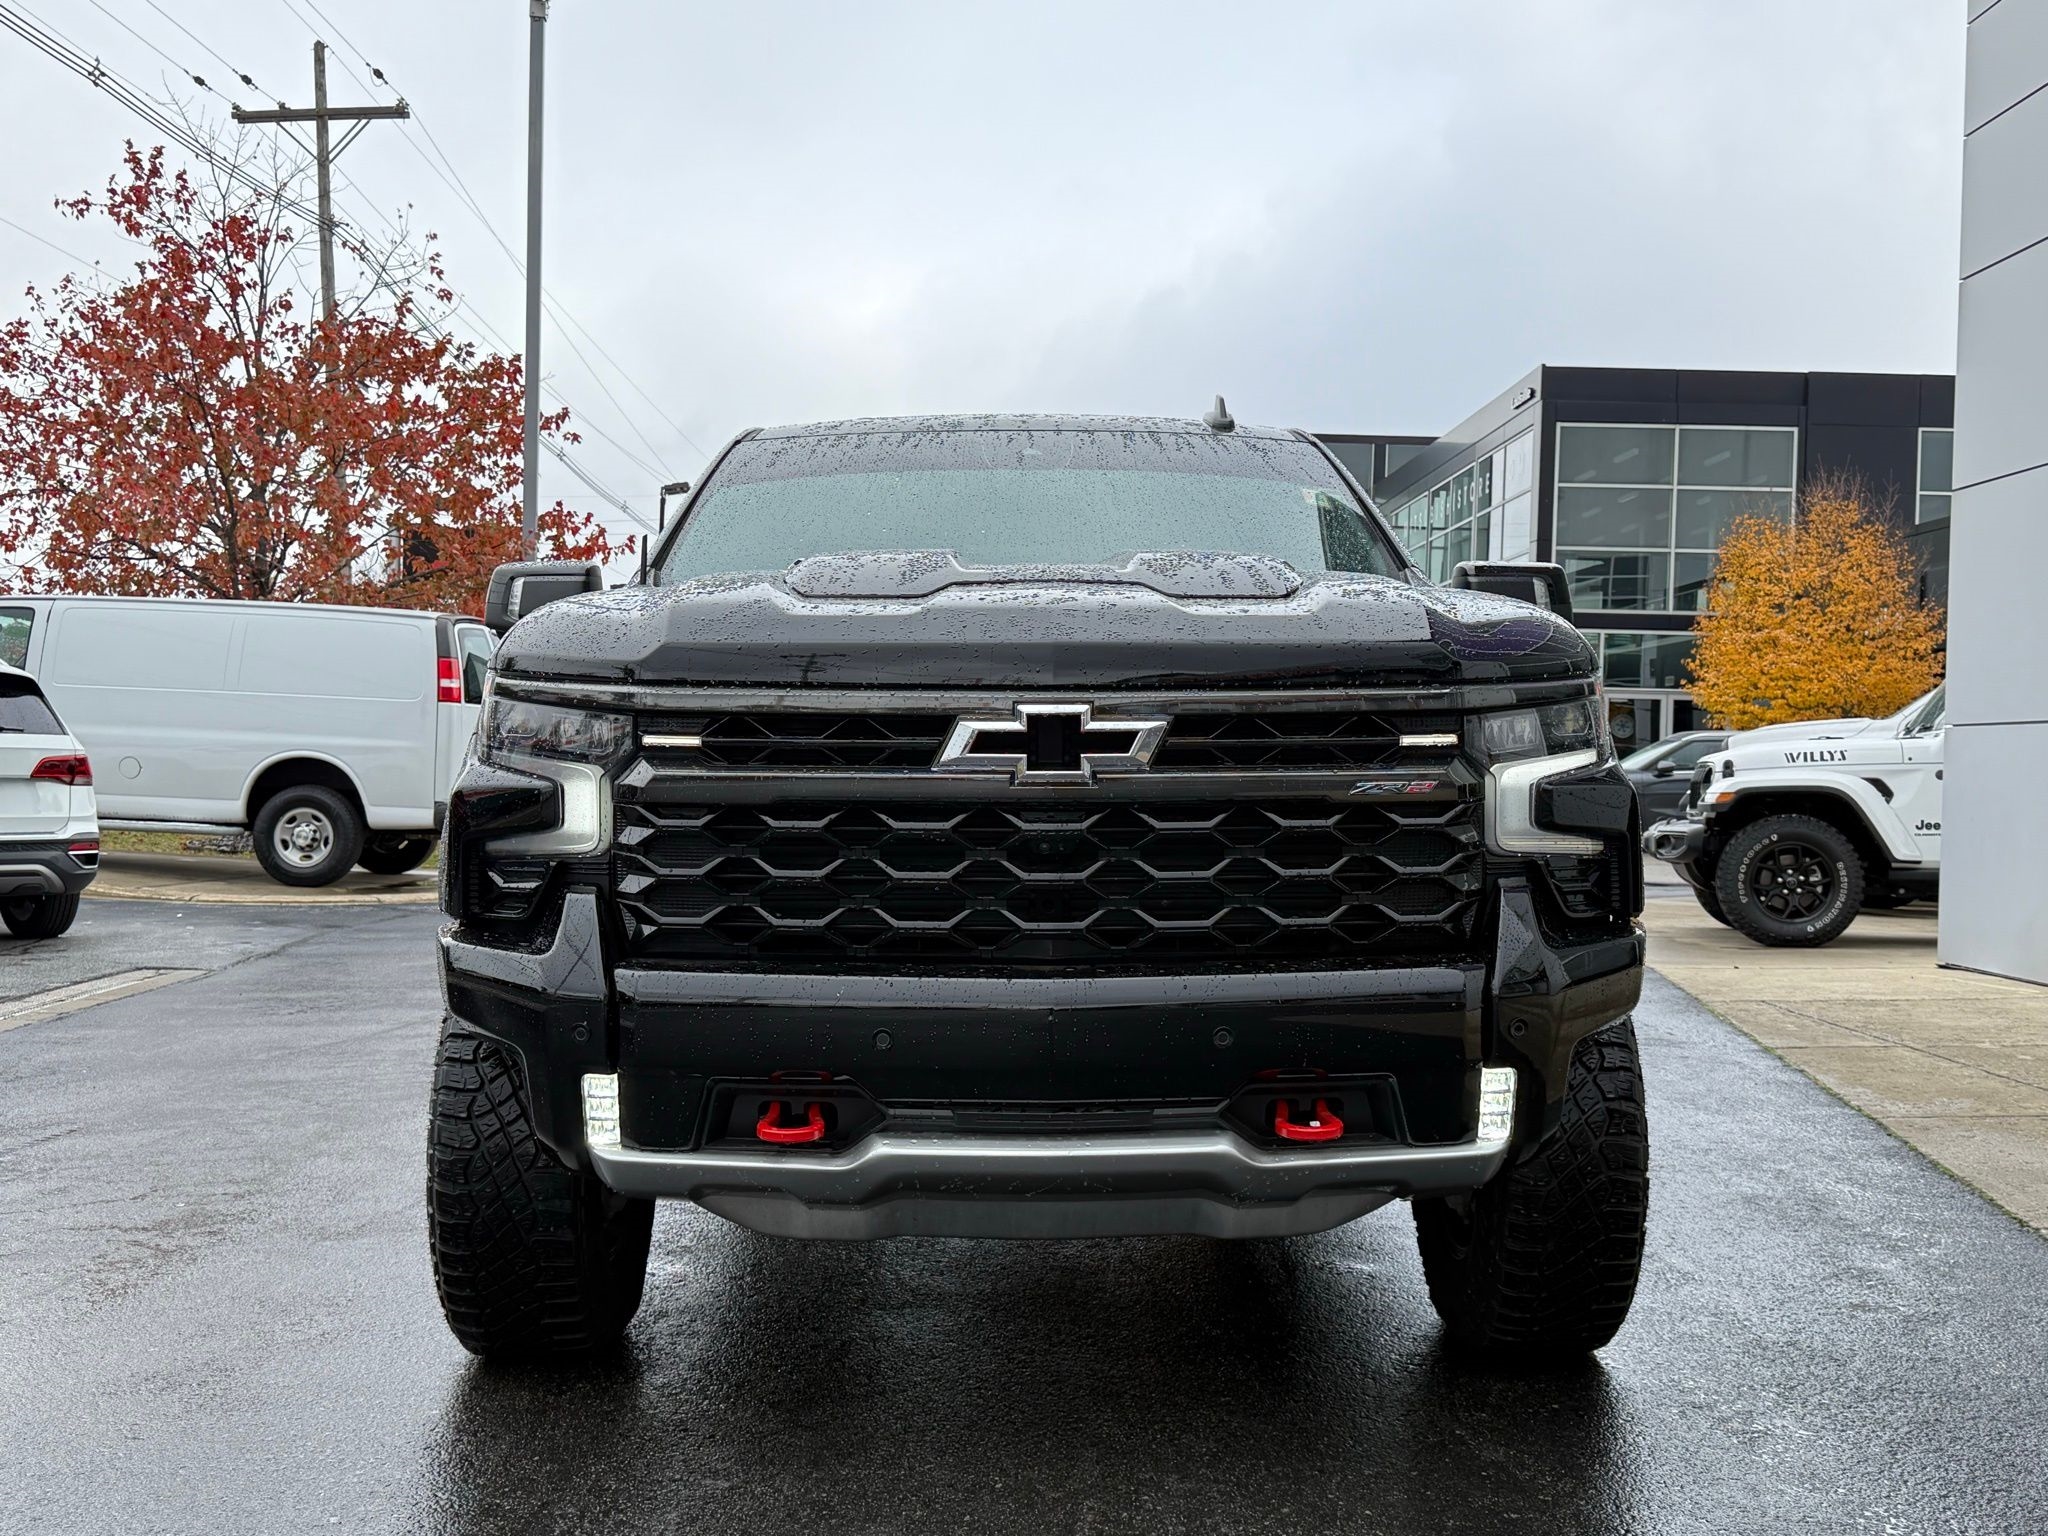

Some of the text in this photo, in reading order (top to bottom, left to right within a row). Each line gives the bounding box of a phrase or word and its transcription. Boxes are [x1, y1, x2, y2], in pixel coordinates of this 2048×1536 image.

[1784, 749, 1848, 764] WILLYS
[1349, 780, 1440, 795] ZR2
[1915, 819, 1942, 831] Jee
